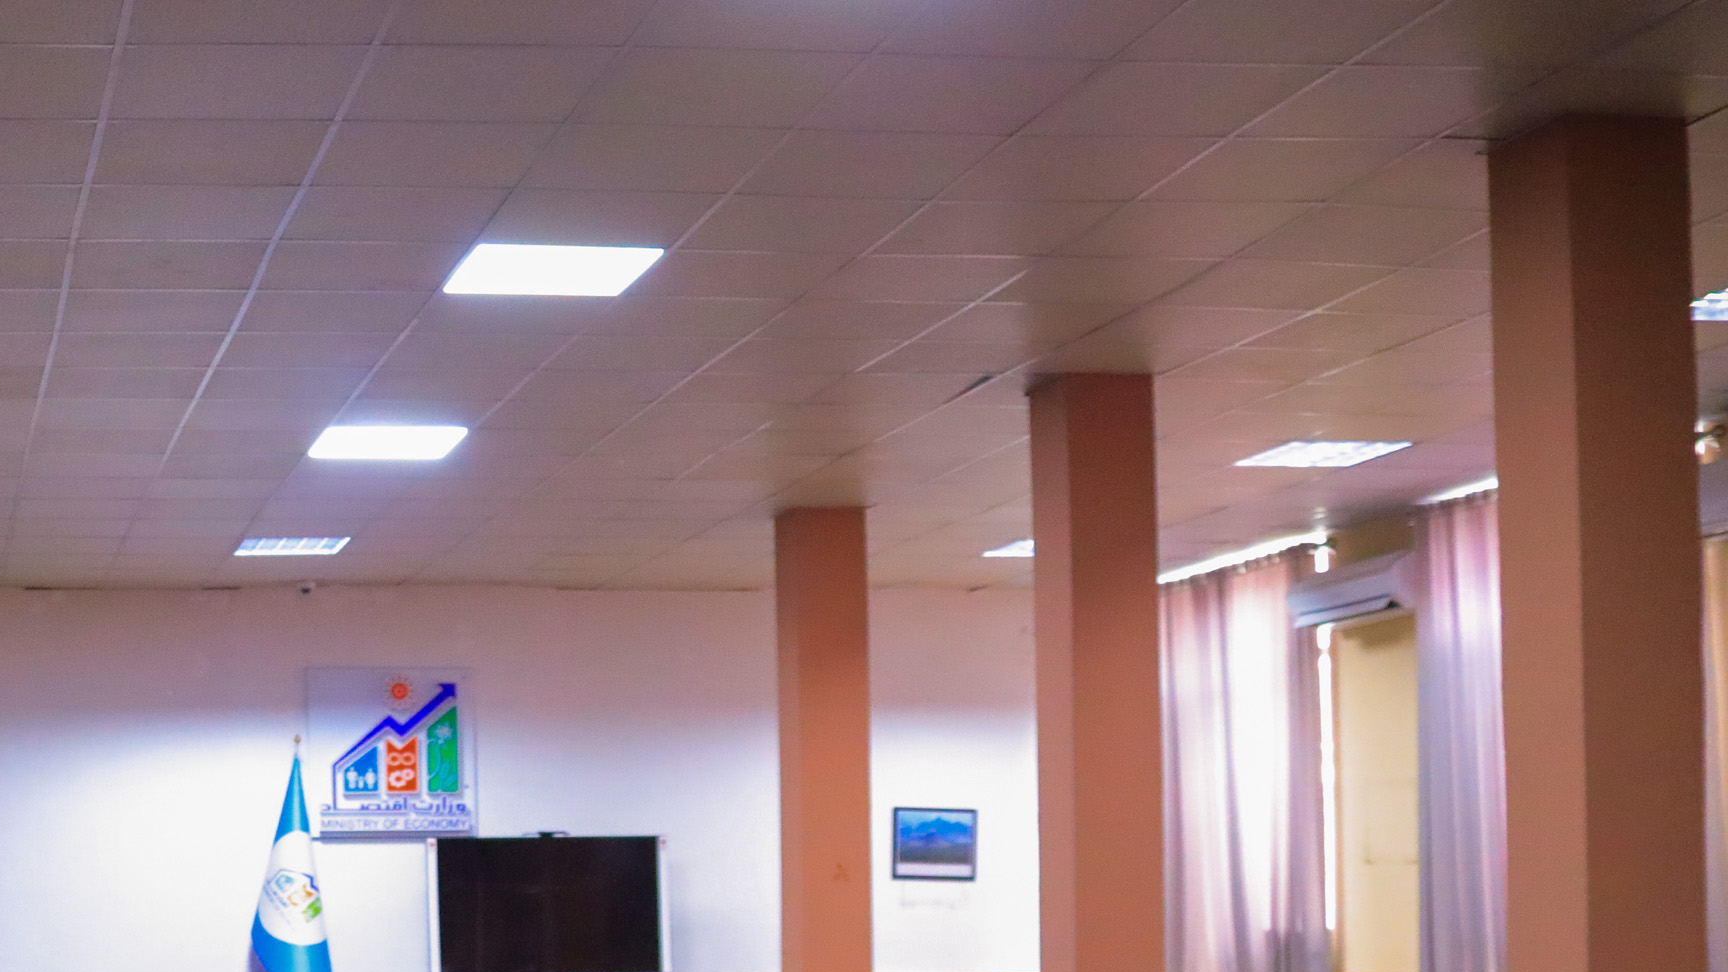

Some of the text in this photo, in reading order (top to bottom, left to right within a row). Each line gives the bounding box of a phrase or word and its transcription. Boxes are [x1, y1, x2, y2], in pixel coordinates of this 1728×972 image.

[413, 796, 467, 814] وزارت
[322, 818, 468, 829] MINISTRY OF ECONOMY
